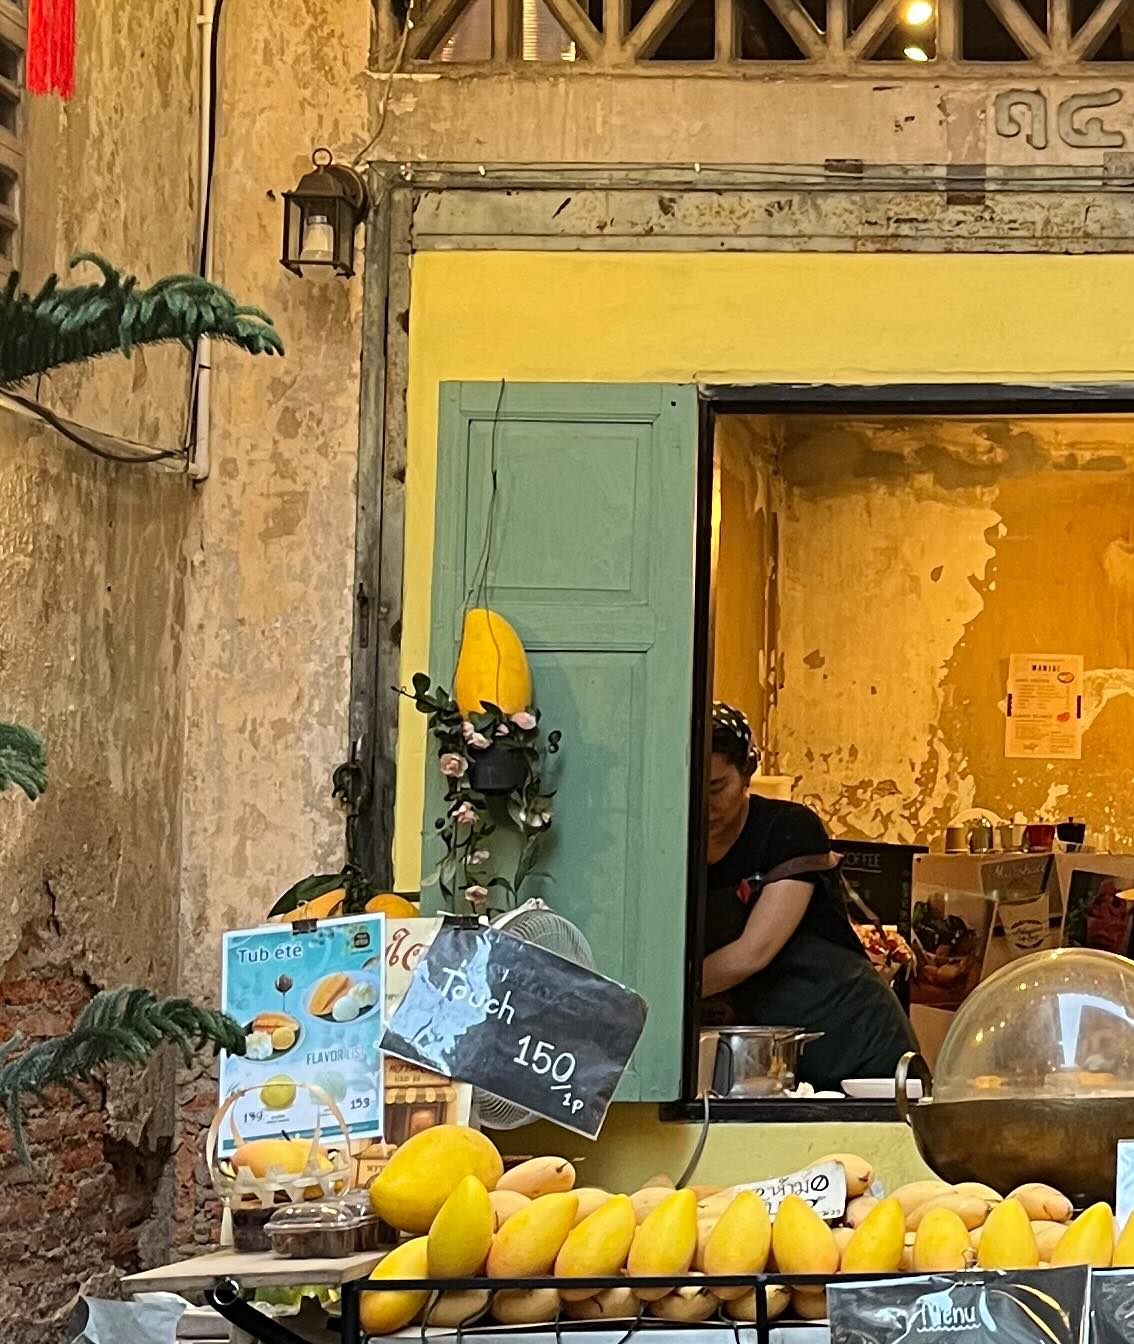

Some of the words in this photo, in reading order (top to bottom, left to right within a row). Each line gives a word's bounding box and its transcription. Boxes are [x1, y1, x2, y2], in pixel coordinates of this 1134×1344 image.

[238, 948, 269, 964] Tub
[306, 1049, 344, 1065] FLAVOR
[513, 1035, 577, 1083] 150
[920, 1303, 977, 1325] Menu
